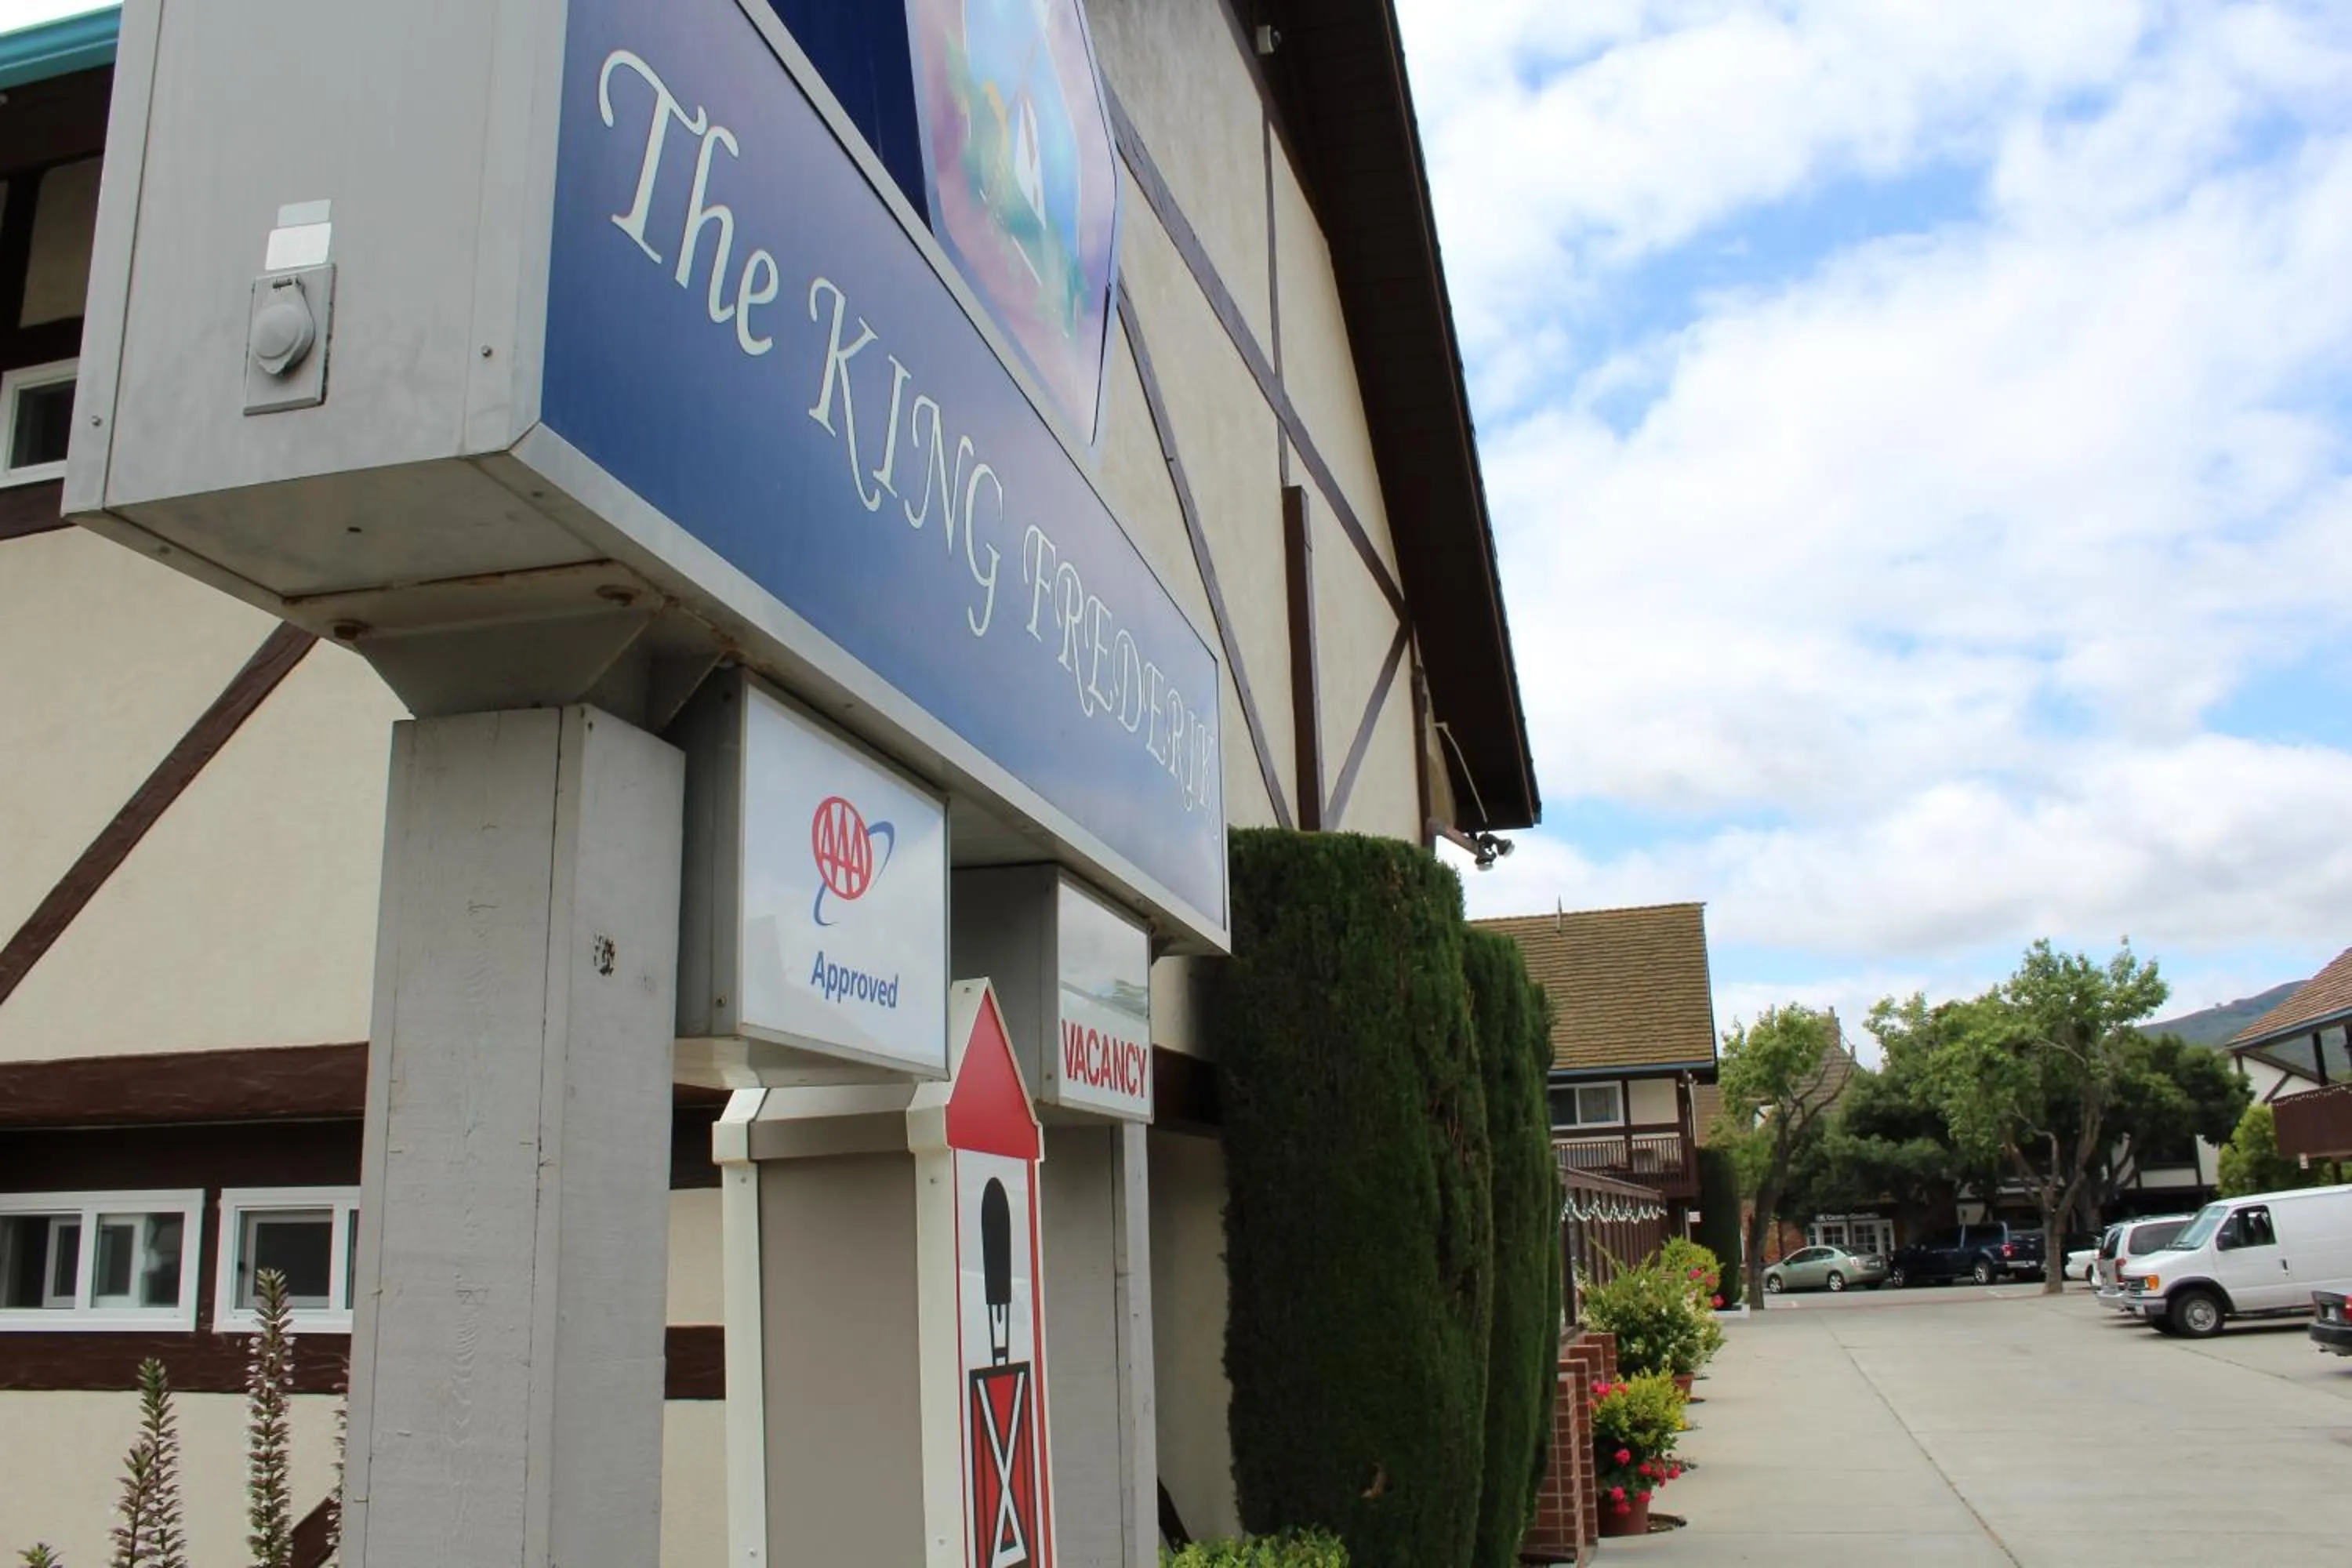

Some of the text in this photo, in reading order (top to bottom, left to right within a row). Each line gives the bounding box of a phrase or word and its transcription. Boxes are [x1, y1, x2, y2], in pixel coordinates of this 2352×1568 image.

[599, 49, 779, 356] The
[808, 276, 1004, 637] KING
[815, 798, 869, 898] AAA
[811, 950, 899, 1009] Approved
[1061, 1018, 1147, 1098] VACANCY
